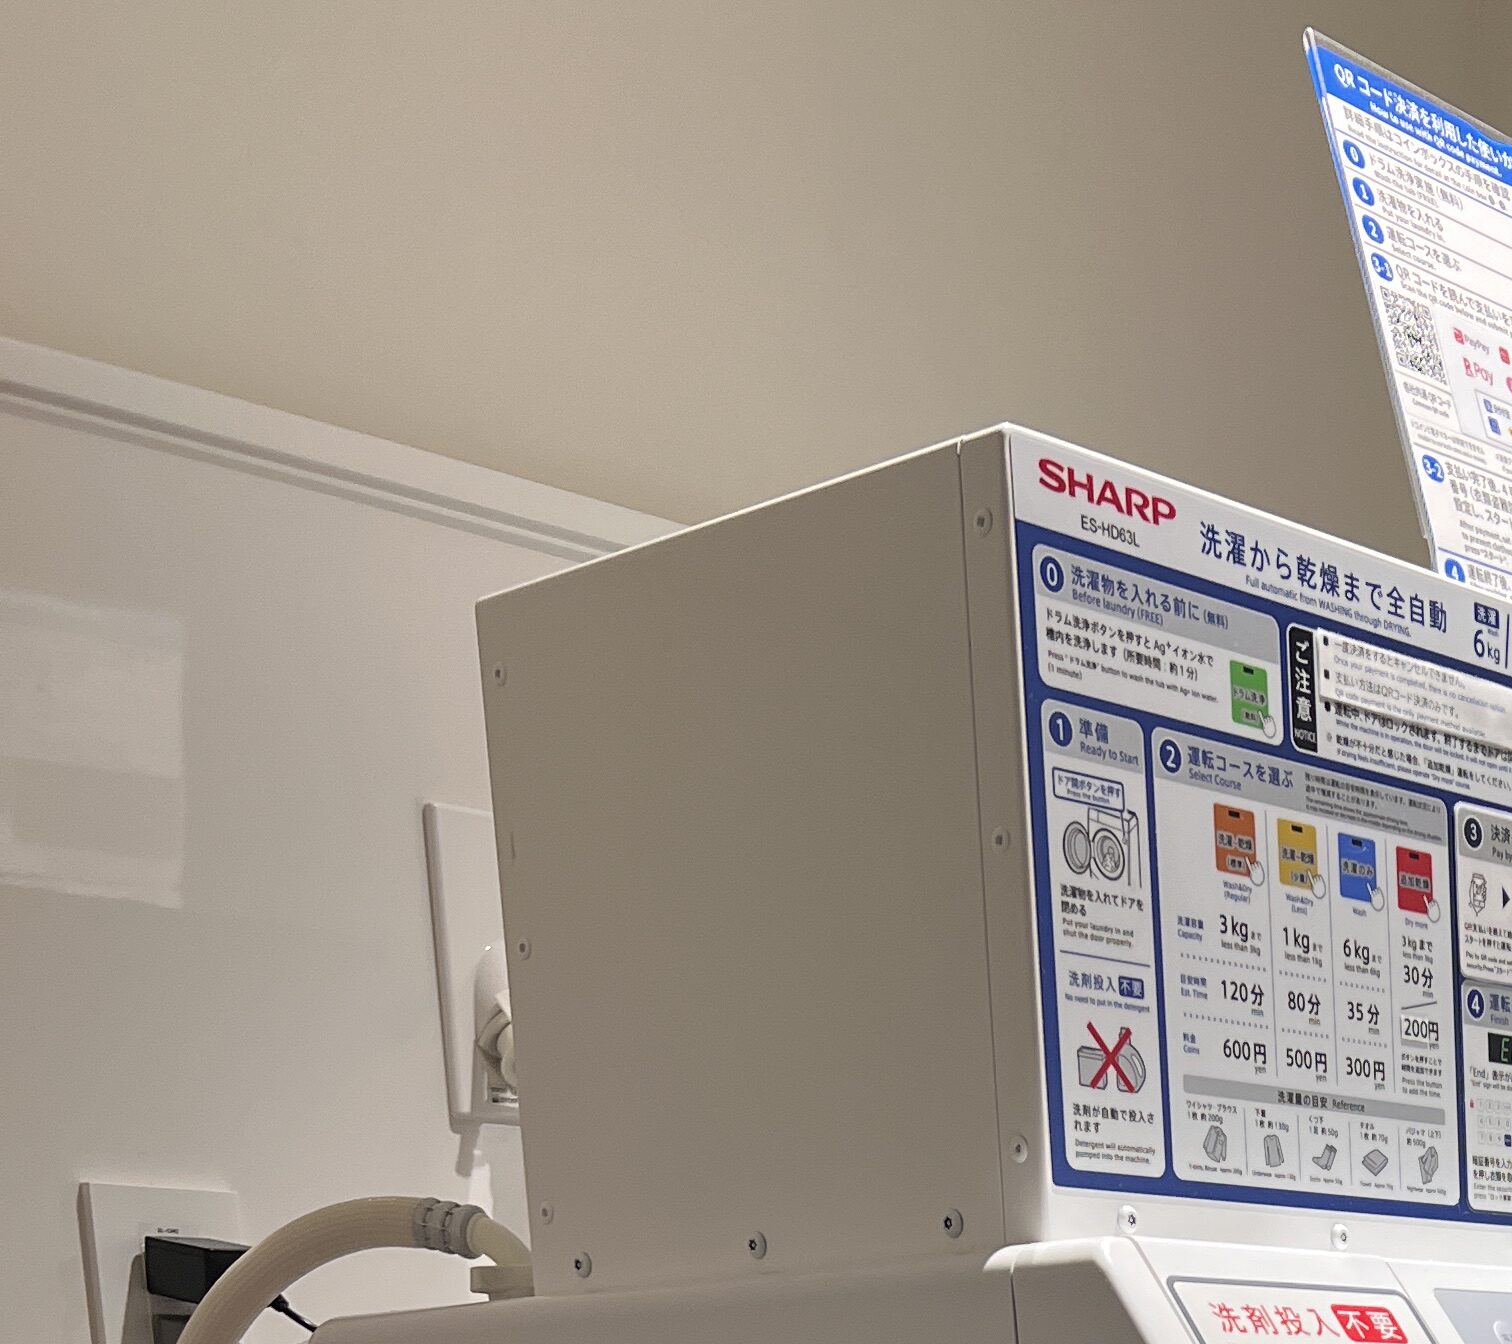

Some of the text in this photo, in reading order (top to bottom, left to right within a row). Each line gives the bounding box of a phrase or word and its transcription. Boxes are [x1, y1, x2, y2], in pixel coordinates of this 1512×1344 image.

[1038, 458, 1176, 526] SHARP
[1080, 513, 1141, 548] ES-HD63L
[1200, 519, 1448, 634] 洗濯から乾燥まで全自動
[1245, 574, 1260, 591] Full
[1071, 563, 1200, 622] 洗濯物を入れる前に
[1072, 589, 1164, 628] Before laundry (FREE)
[1294, 639, 1313, 724] ご注意
[1079, 717, 1109, 746] 準備
[1080, 740, 1107, 760] Ready
[1118, 751, 1140, 768] Start
[1187, 745, 1294, 789] 運転コースを選ぶ
[1189, 767, 1242, 792] Select Course
[1068, 969, 1117, 994] 洗剤投入
[1403, 964, 1434, 990] 30分
[1220, 979, 1265, 1007] 120分
[1287, 991, 1321, 1017] 80分
[1347, 1001, 1380, 1026] 35分
[1403, 1018, 1440, 1043] 200円
[1223, 1038, 1267, 1066] 600円
[1286, 1048, 1328, 1074] 500円
[1345, 1056, 1386, 1082] 300円
[1072, 1103, 1155, 1125] 洗剤が自動で投入さ
[1074, 1118, 1101, 1135] れます
[1208, 1301, 1404, 1342] 洗剤投入 不要
